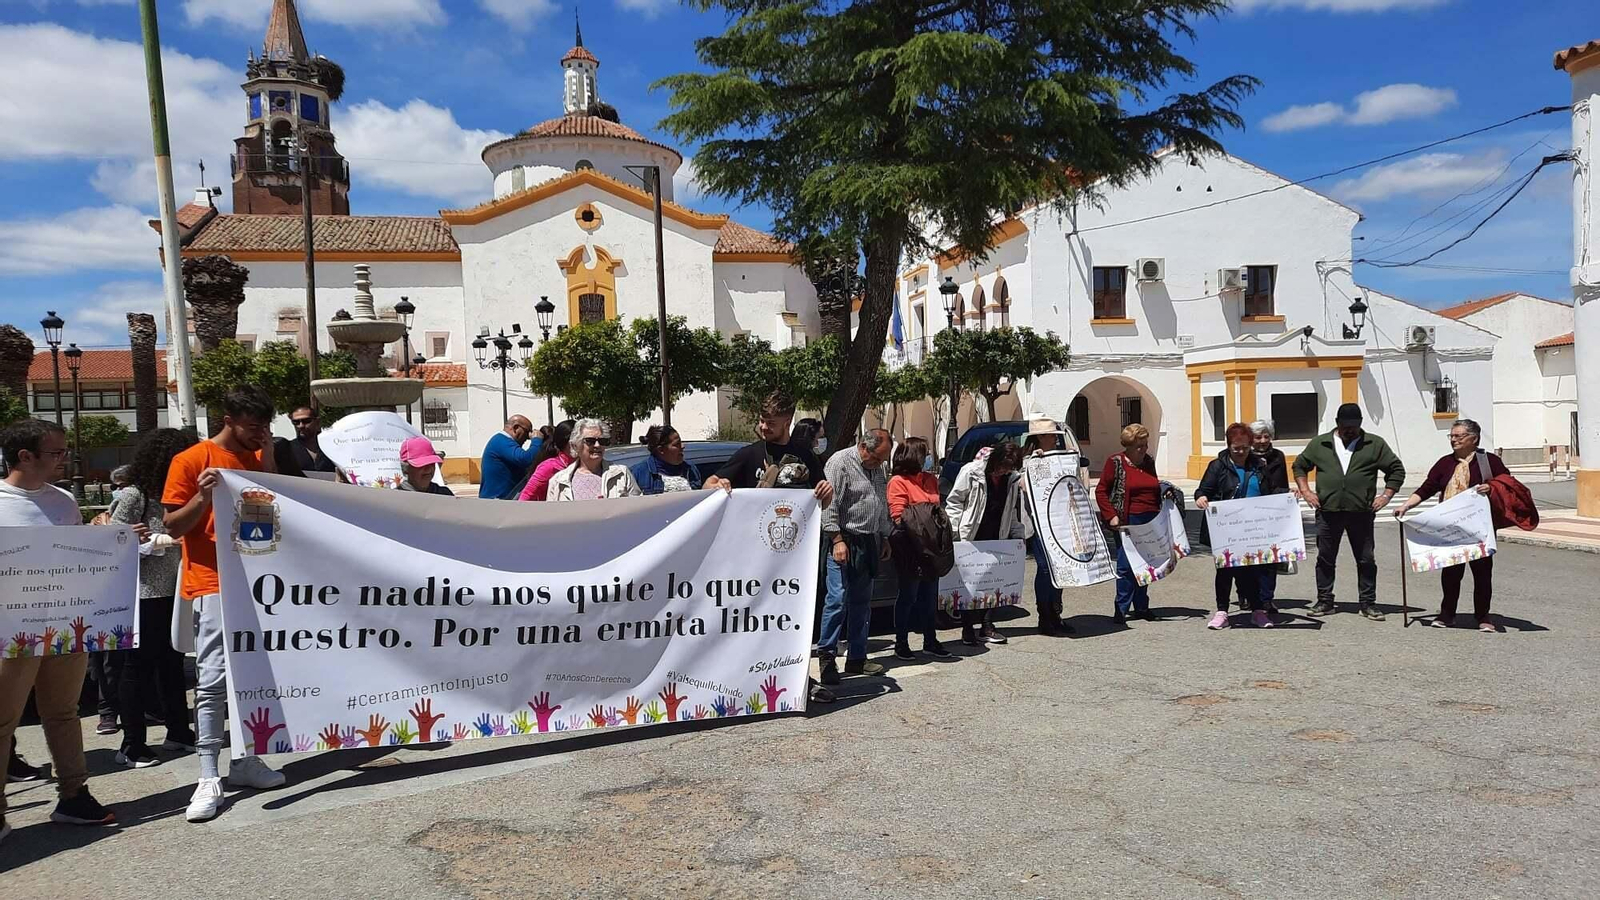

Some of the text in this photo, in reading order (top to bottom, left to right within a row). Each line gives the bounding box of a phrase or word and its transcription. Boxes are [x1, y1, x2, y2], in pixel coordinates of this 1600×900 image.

[26, 568, 45, 576] nos
[48, 565, 75, 577] quite
[78, 564, 87, 574] lo
[89, 566, 107, 576] que
[22, 583, 65, 593] nuestro.
[31, 598, 67, 609] ermita
[69, 596, 96, 607] libre.
[252, 572, 801, 616] Que nadie nos quite lo que es
[231, 606, 802, 653] nuestro. Por una ermita libre.
[346, 671, 510, 711] #CerramientoInjusto
[666, 670, 744, 699] #ValsequilloUnido
